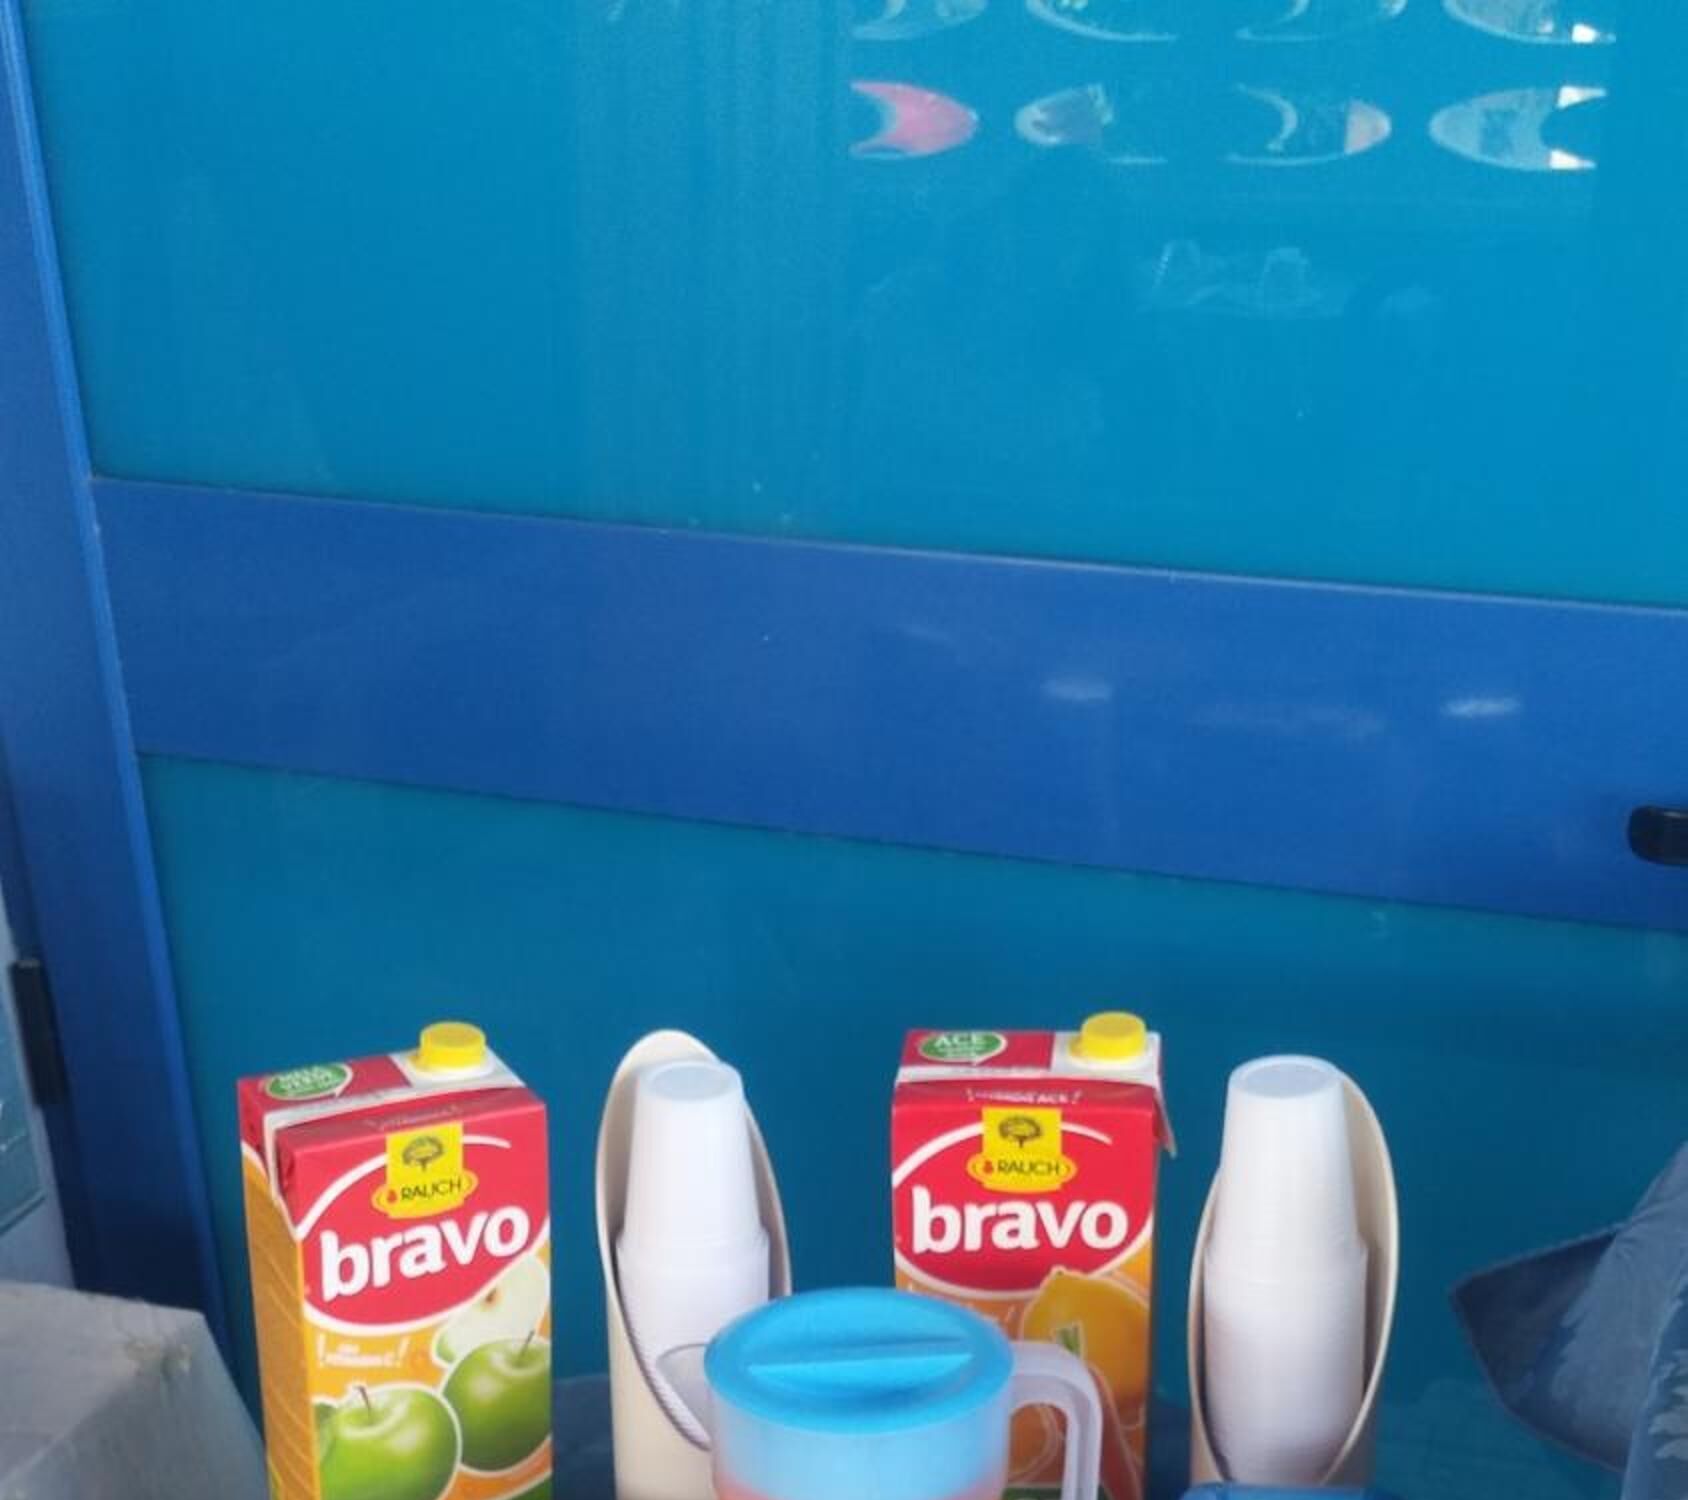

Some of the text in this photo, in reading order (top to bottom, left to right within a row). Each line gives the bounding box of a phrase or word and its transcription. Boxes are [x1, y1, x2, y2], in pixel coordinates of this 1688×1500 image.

[401, 1178, 462, 1201] RAUCH
[998, 1159, 1060, 1176] RAUCH
[912, 1186, 1129, 1255] bravo
[320, 1206, 530, 1302] bravo
